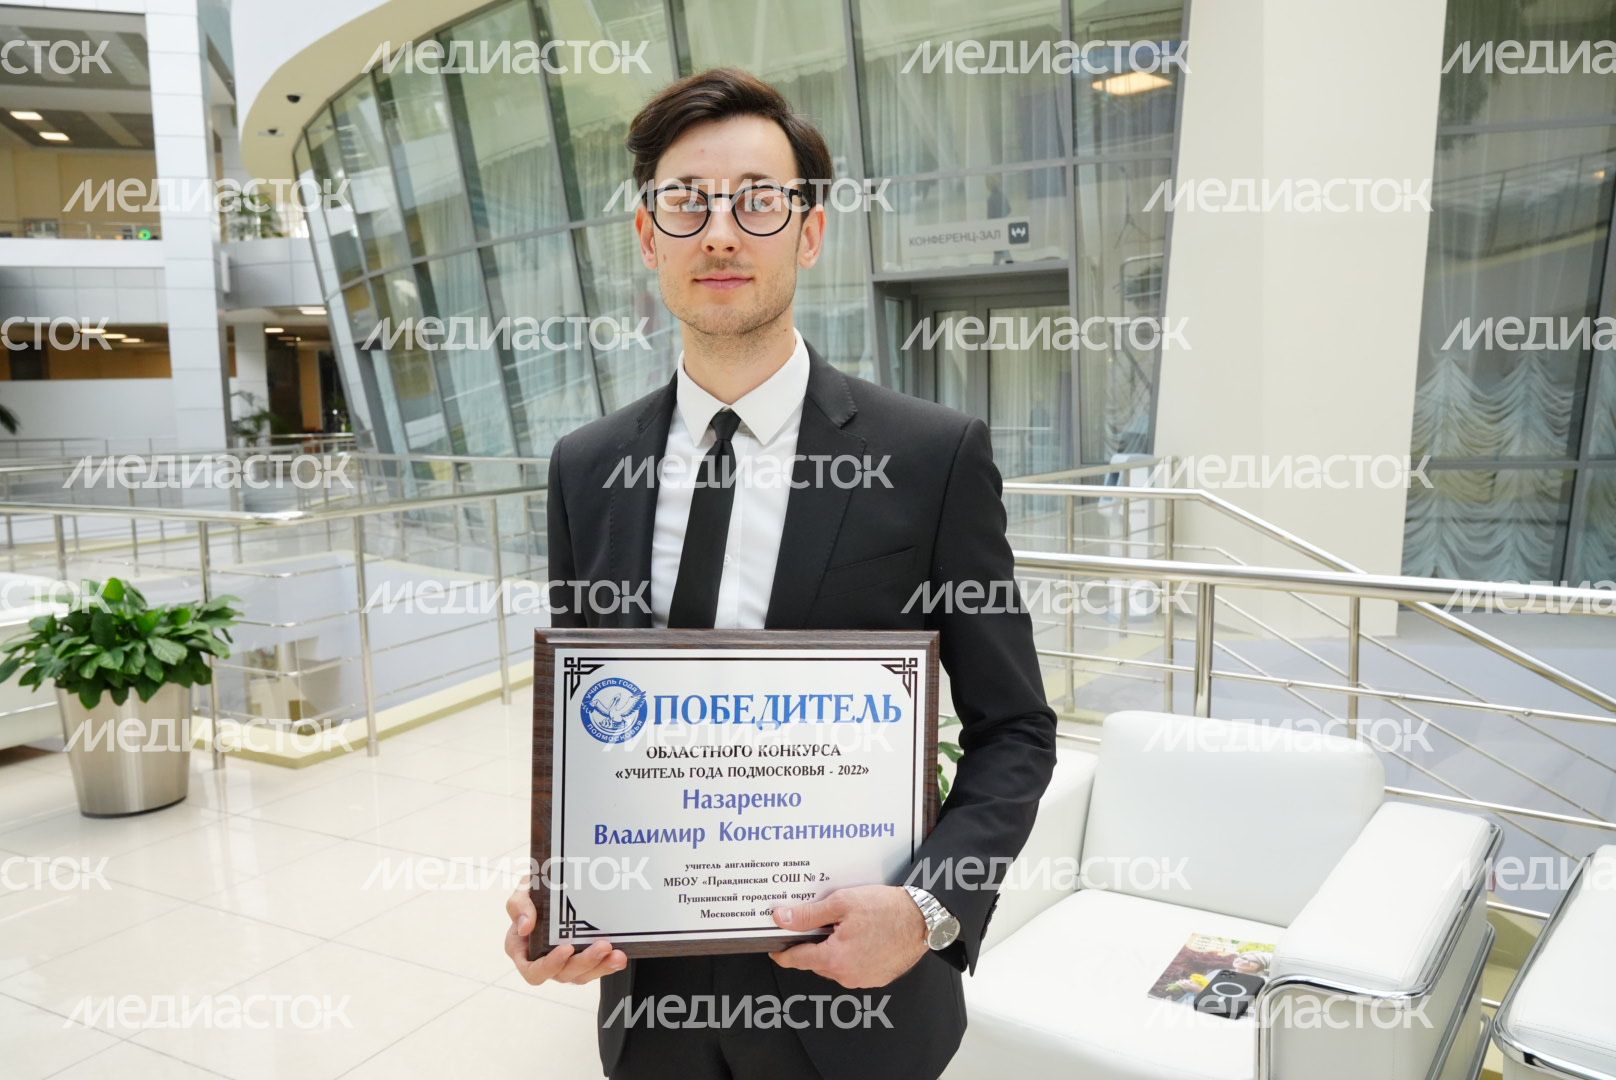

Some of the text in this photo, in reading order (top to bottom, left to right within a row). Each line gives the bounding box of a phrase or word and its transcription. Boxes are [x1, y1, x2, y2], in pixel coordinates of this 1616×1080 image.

[908, 229, 1001, 247] КОНФЕРЕНЦ-ЗАЛ
[585, 679, 617, 700] УЧИТЕЛЬ
[653, 692, 902, 731] ПОБЕДИТЕЛЬ
[587, 720, 643, 742] ПОДМОСКОВЬЯ
[646, 743, 841, 760] ОБЛАСТНОГО КОНКУРСА
[615, 767, 685, 780] «УЧИТЕЛЬ
[689, 766, 723, 779] ГОДА
[727, 765, 825, 779] ПОДМОСКОВЬЯ
[838, 764, 869, 776] 2022»
[683, 788, 802, 815] Назаренко
[594, 821, 895, 849] Владимир Константинович
[685, 860, 810, 872] учитель английского языка
[664, 872, 830, 888] МБОУ «Правдинская СОШ № 2»
[678, 891, 816, 905] Пушкинский городской округ
[700, 907, 756, 919] Московской
